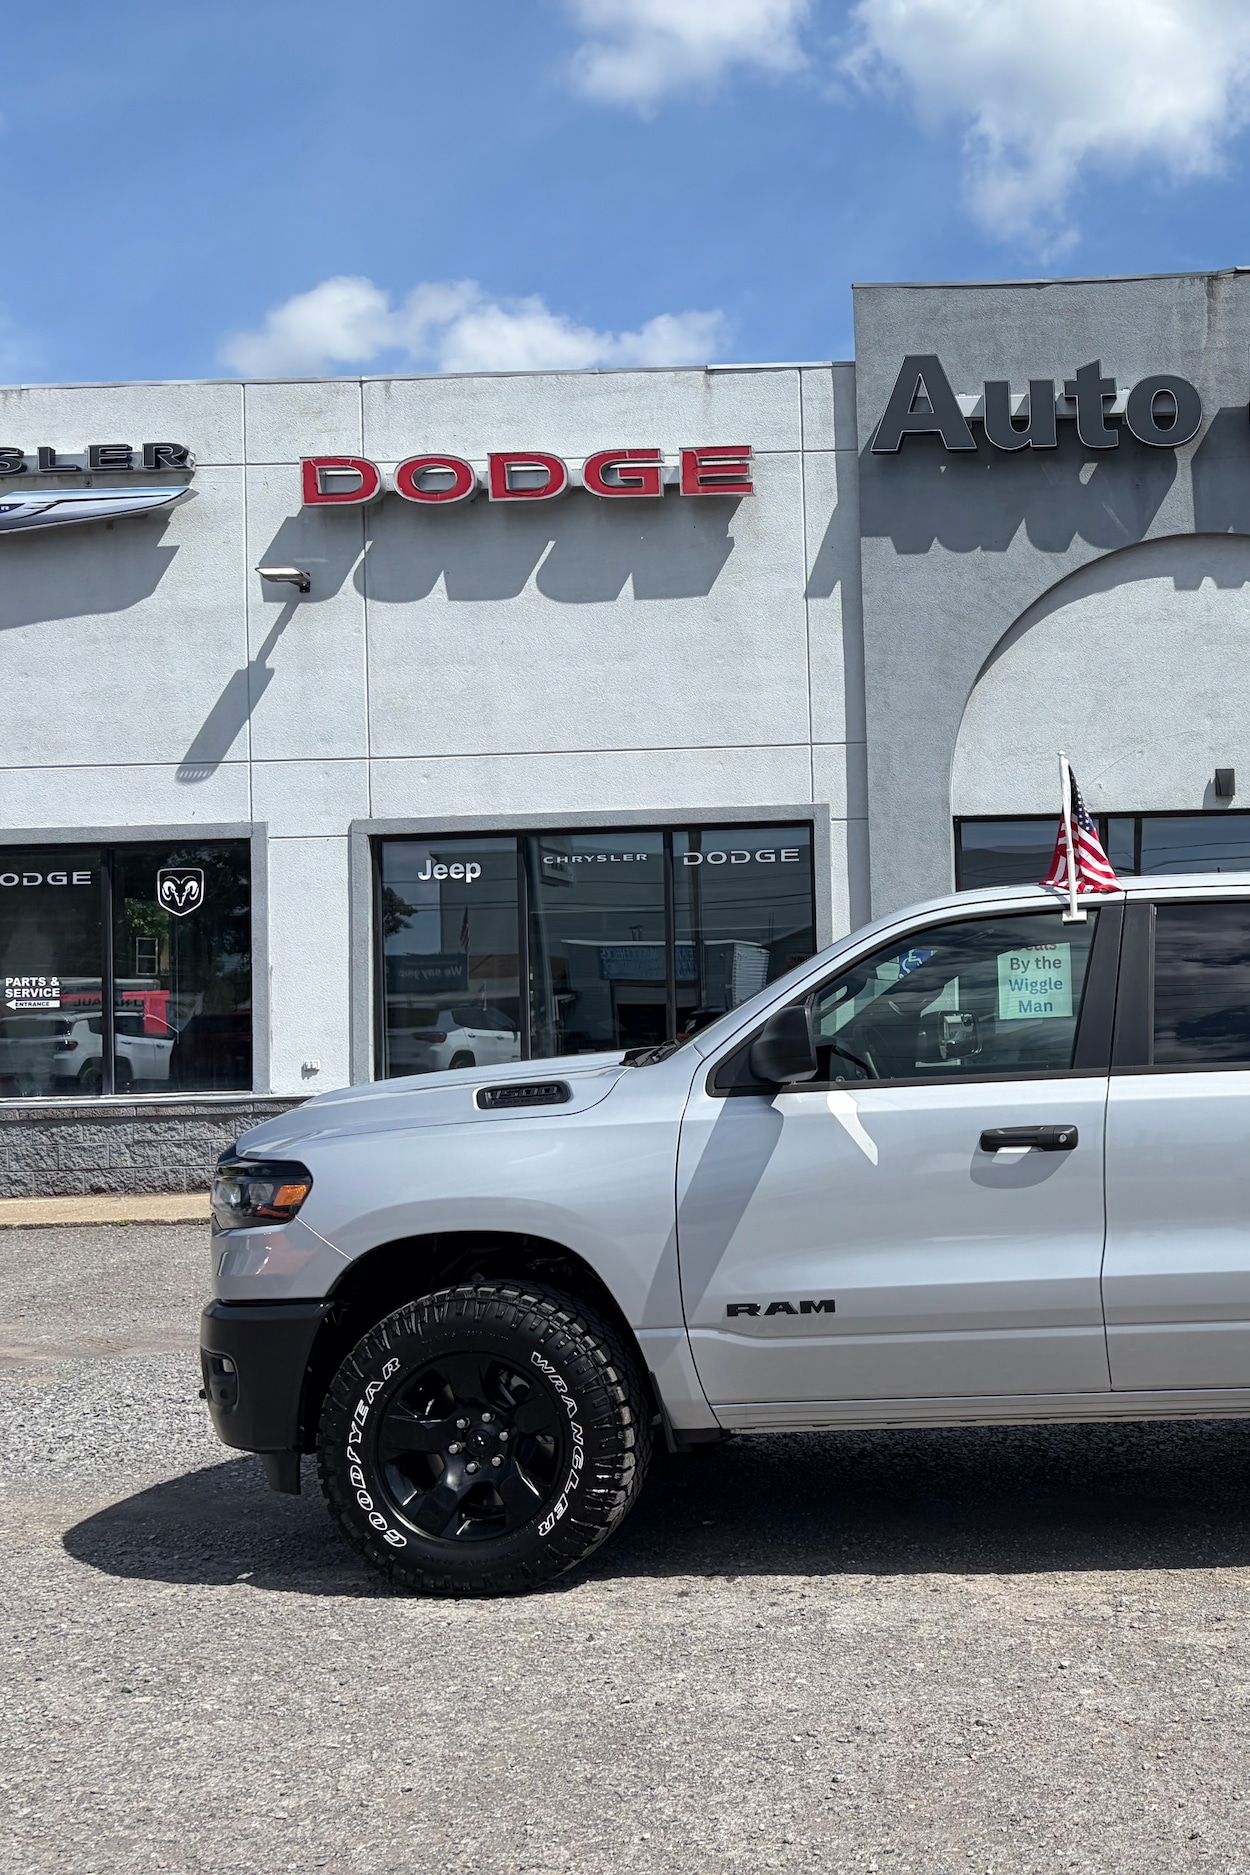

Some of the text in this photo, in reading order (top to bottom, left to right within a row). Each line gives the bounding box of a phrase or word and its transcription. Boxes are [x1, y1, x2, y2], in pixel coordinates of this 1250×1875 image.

[871, 353, 1202, 454] Auto
[300, 446, 754, 505] DODGE
[543, 853, 649, 865] CHRYSLER
[683, 848, 800, 866] DODGE
[417, 860, 482, 883] Jeep
[1010, 956, 1062, 973] By the
[5, 976, 60, 987] PARTS &
[1009, 977, 1063, 995] Wiggle
[5, 988, 61, 998] SERVICE
[1018, 999, 1053, 1013] Man
[726, 1300, 836, 1317] RAM
[346, 1357, 407, 1548] GOODYEAR
[531, 1351, 584, 1536] WRANGLER
